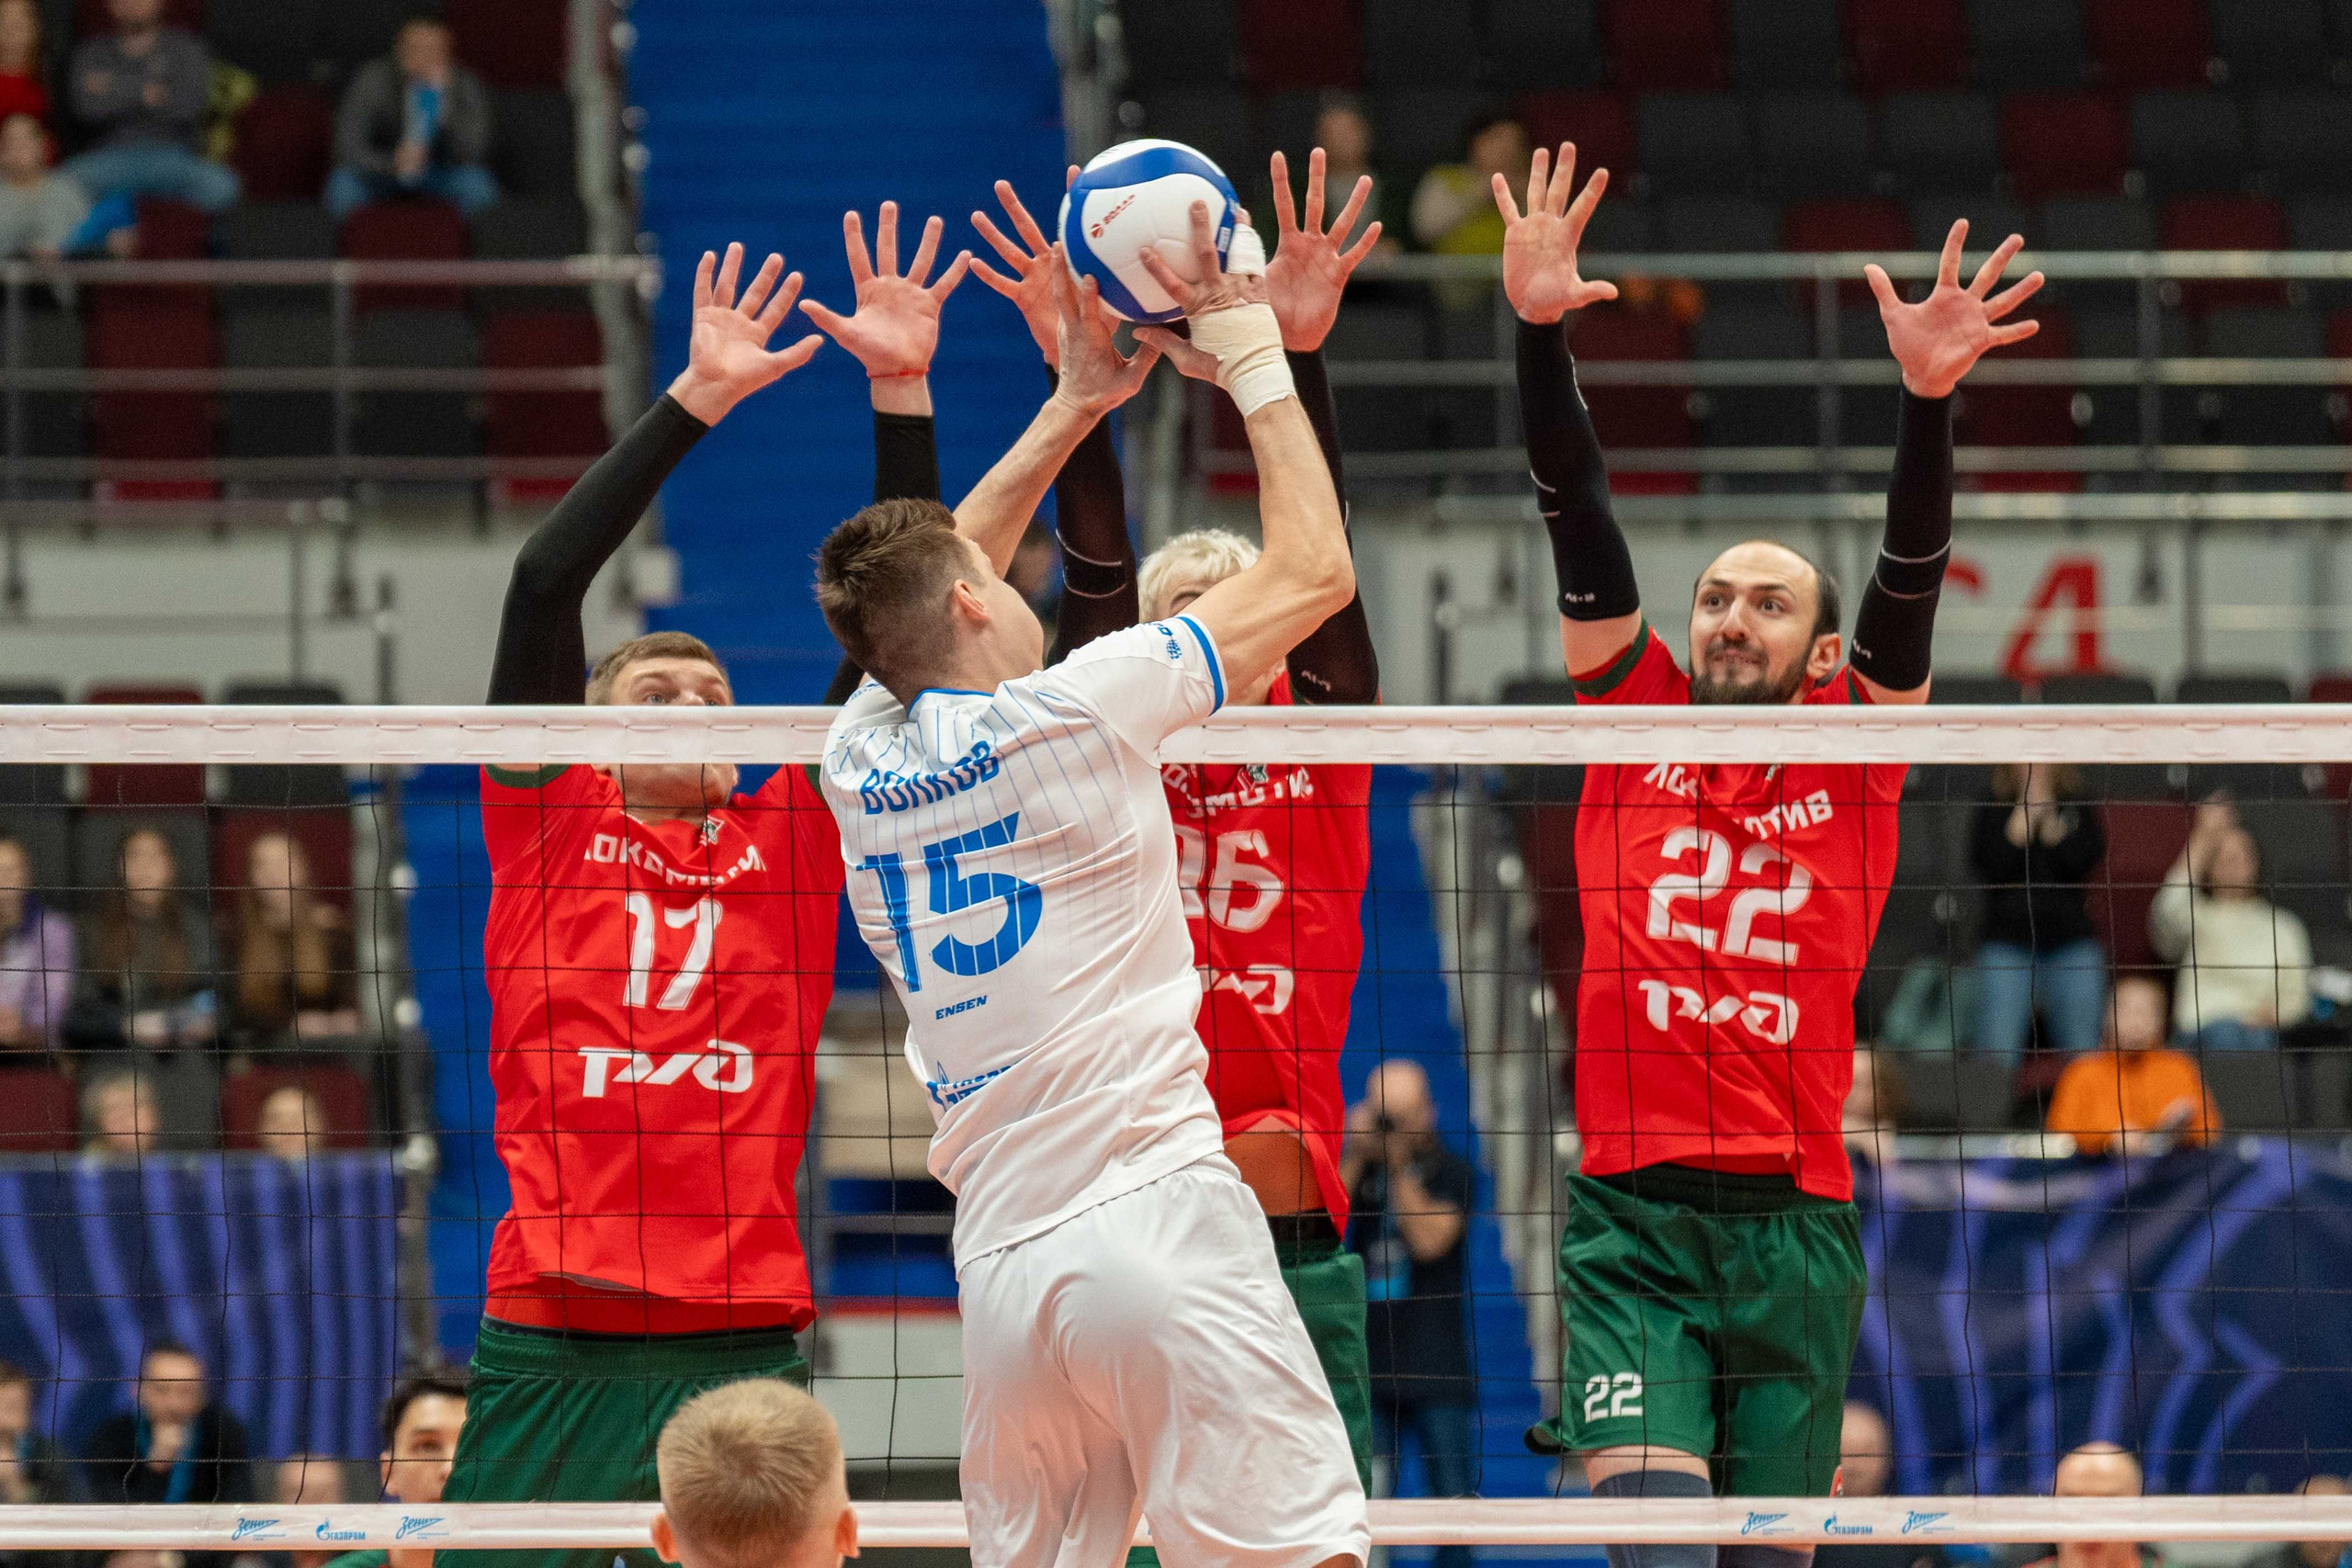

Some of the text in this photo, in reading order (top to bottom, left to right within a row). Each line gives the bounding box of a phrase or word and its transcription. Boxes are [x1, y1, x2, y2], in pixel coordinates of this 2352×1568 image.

[623, 891, 723, 1010] 17
[856, 810, 1043, 994] 15
[1645, 826, 1813, 966] 22
[1584, 1371, 1644, 1423] 22
